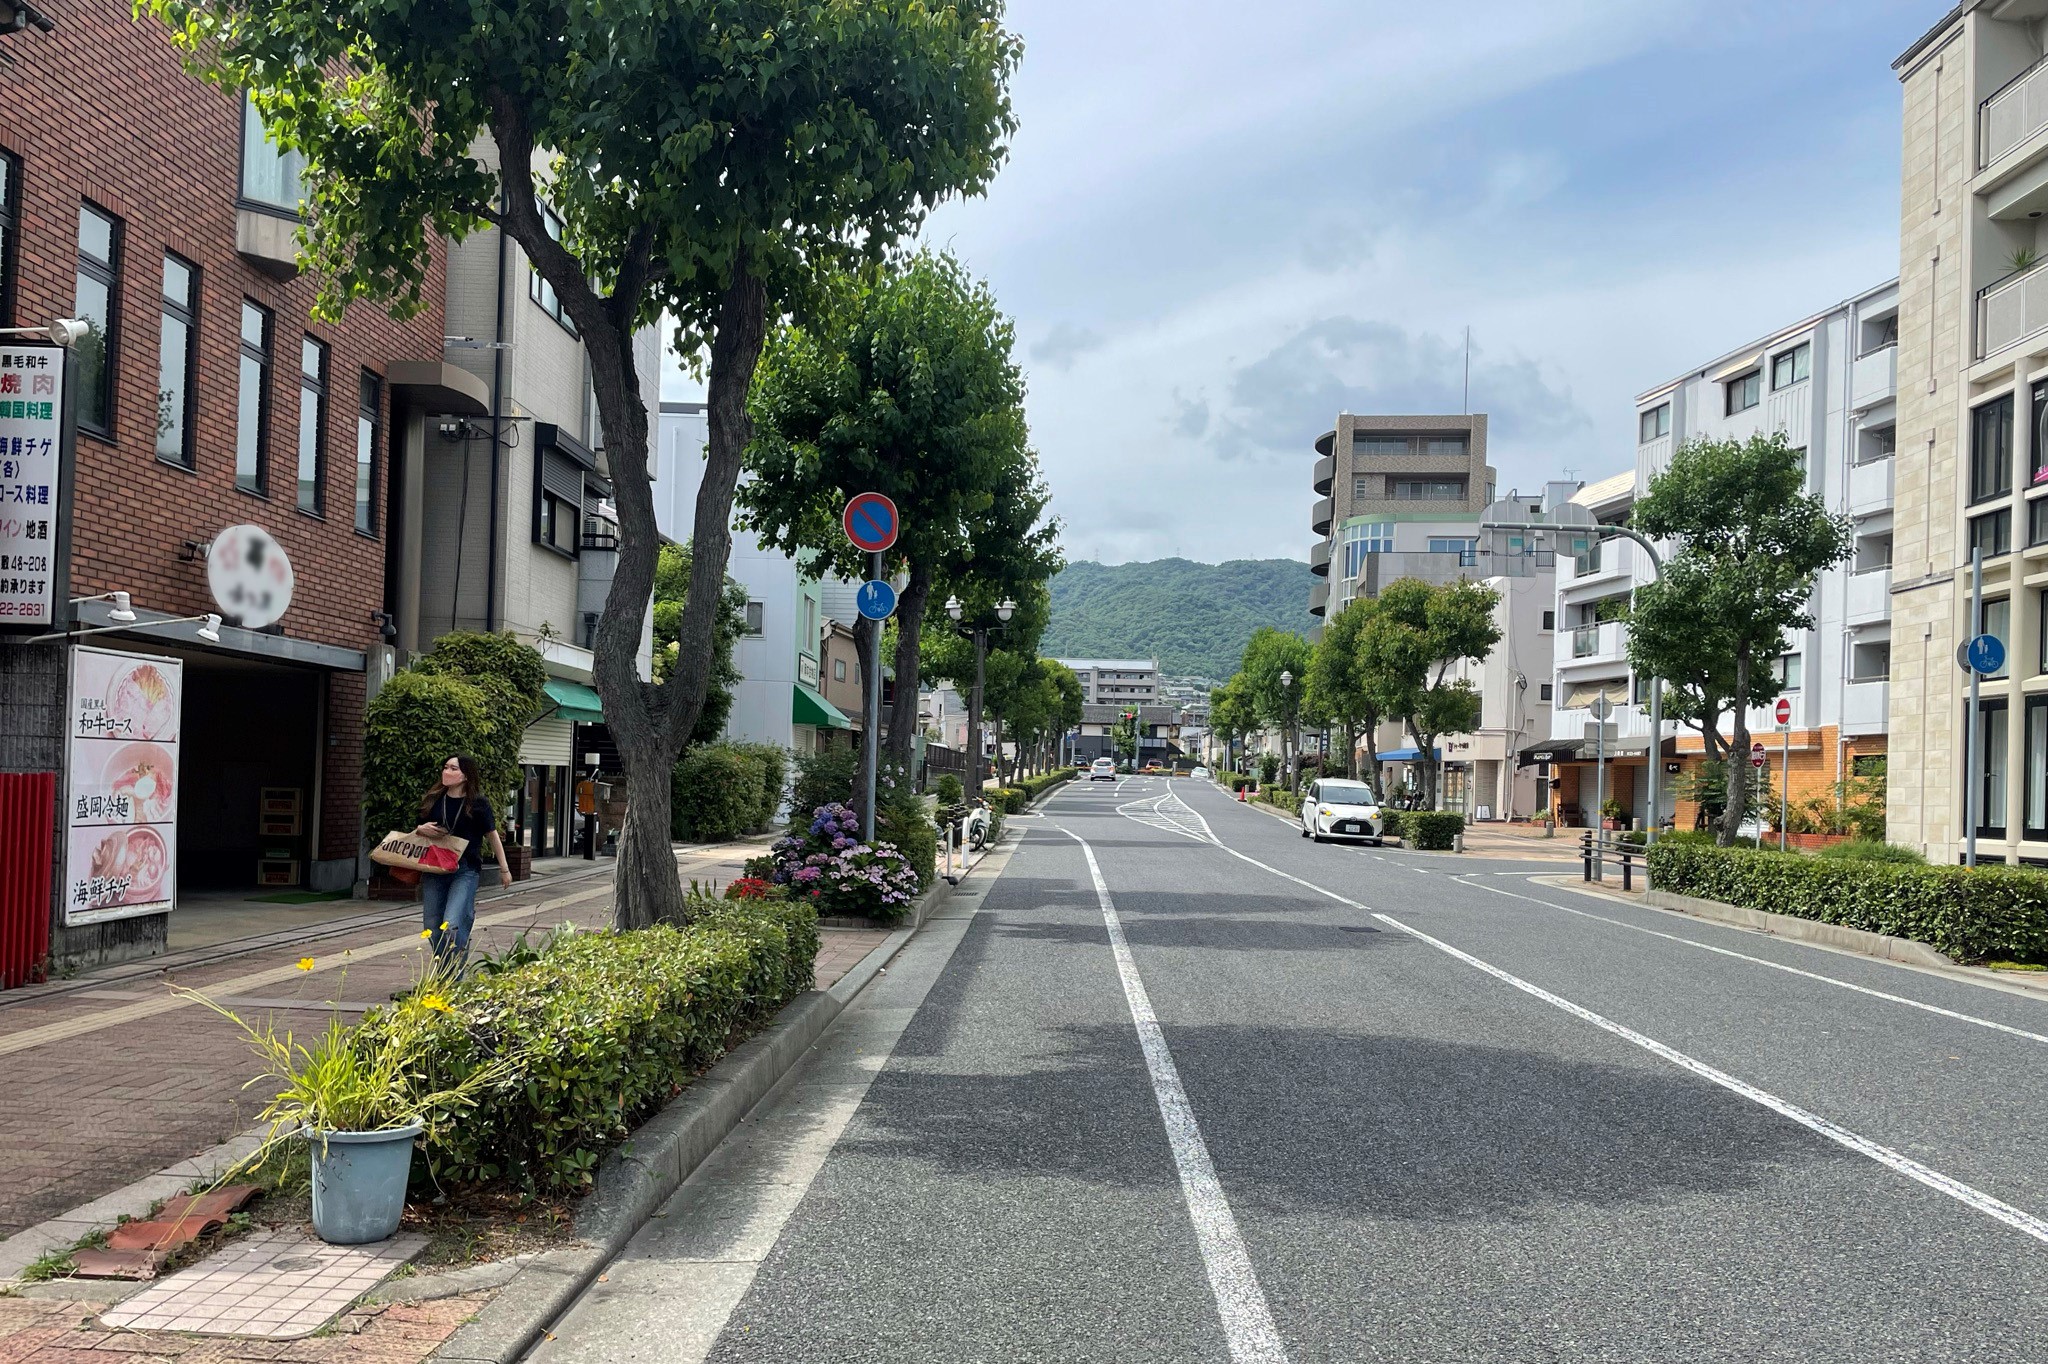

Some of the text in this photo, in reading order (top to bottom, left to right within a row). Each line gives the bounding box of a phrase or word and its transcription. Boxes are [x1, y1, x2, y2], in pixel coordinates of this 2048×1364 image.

[2, 354, 49, 369] 黒毛和牛
[0, 400, 53, 420] 韓国料理
[0, 601, 45, 617] 22-2631
[78, 712, 133, 735] 和牛ロース
[72, 875, 132, 906] 海鮮チゲ
